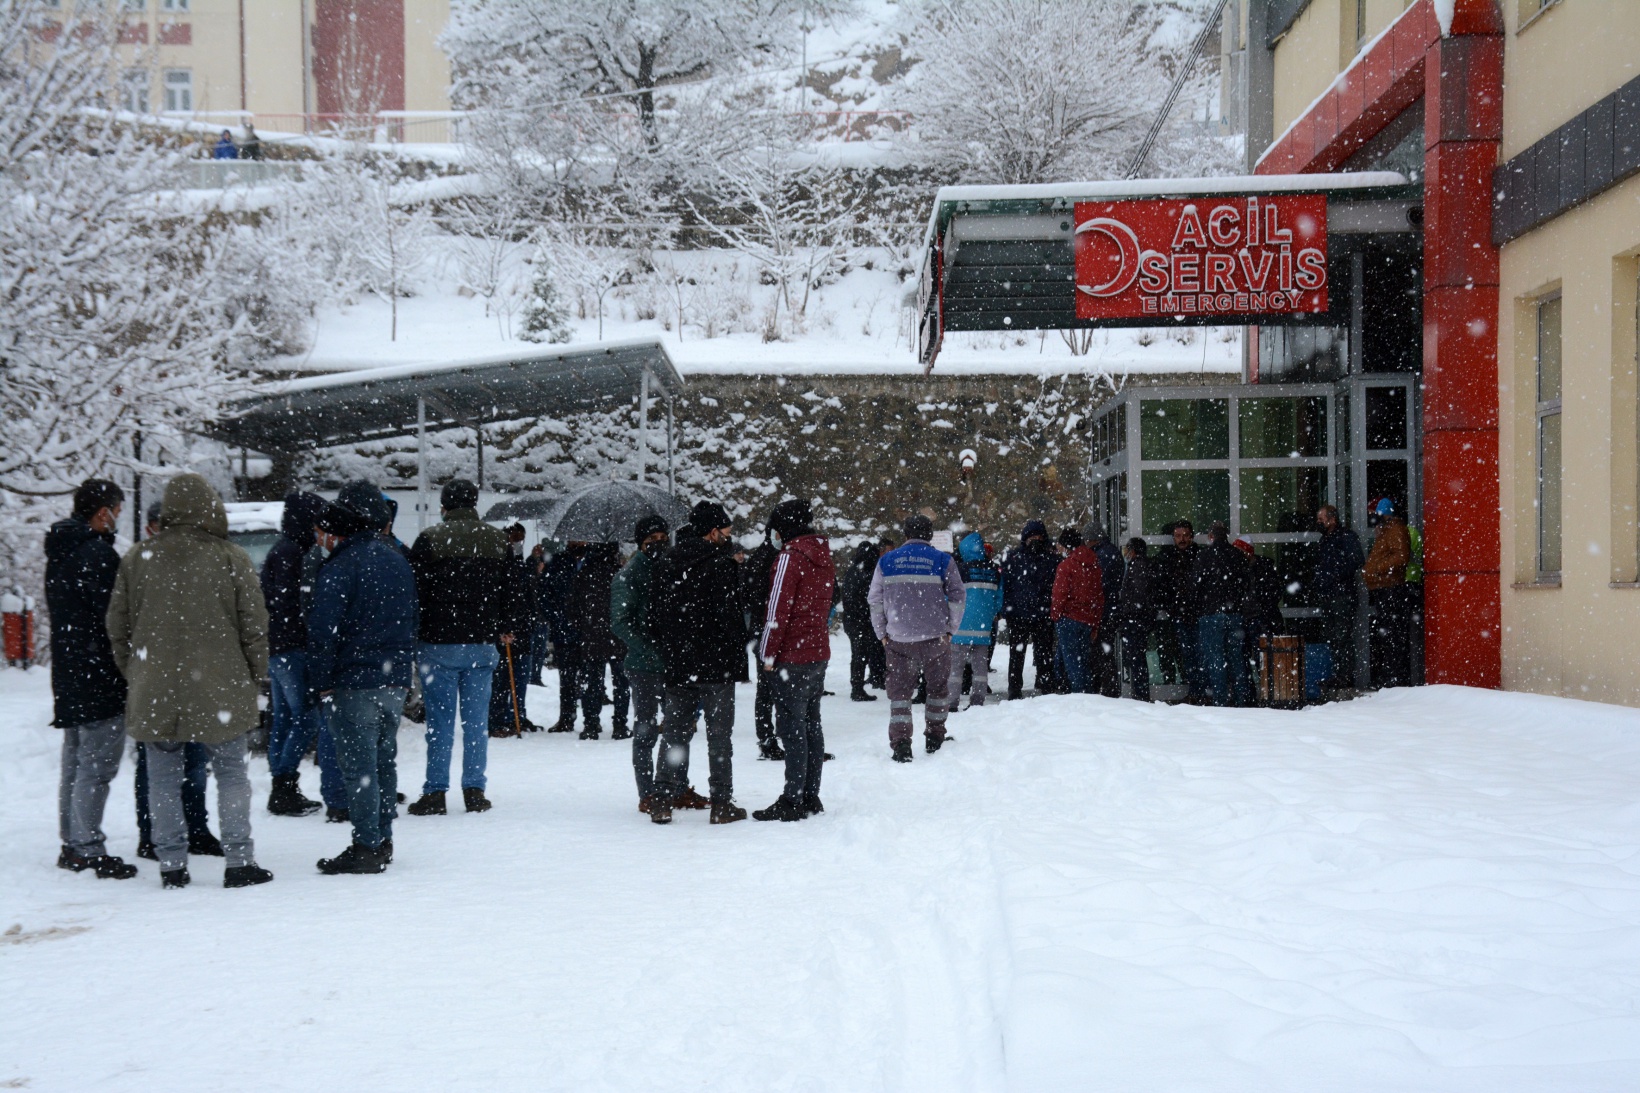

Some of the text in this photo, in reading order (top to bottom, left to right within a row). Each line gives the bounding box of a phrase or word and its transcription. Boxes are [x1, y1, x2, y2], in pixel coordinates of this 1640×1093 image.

[1171, 196, 1293, 248] ACİL
[1139, 244, 1326, 293] SERVİS
[1142, 290, 1304, 314] EMERGENCY
